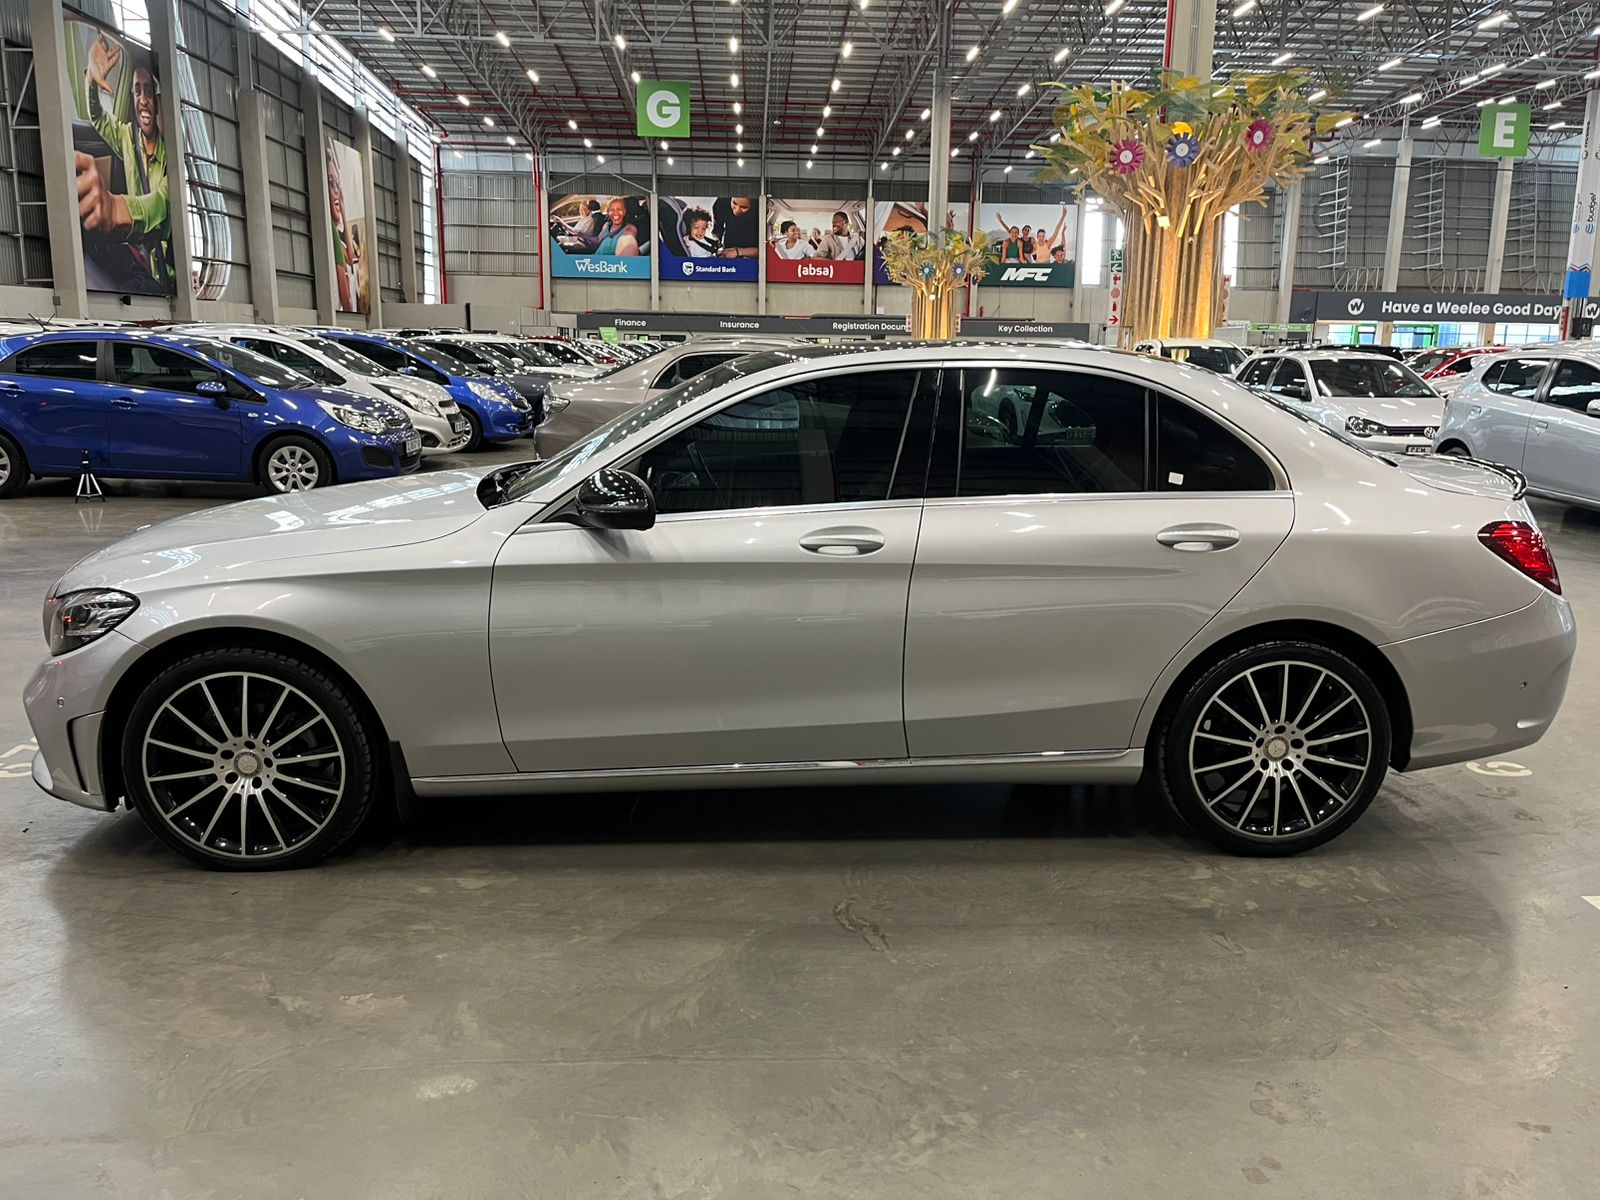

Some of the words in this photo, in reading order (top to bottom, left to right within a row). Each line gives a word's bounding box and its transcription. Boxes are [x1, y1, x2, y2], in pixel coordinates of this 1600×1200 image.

[646, 90, 681, 128] G
[1493, 112, 1517, 148] E
[575, 258, 628, 273] WesBank
[695, 265, 721, 273] Standard
[1000, 267, 1052, 281] MFC
[1381, 301, 1420, 313] Have
[1423, 303, 1433, 314] a
[1436, 301, 1490, 315] Weelee
[1493, 303, 1531, 316] Good
[1533, 303, 1561, 320] Day
[614, 318, 647, 327] Finance
[720, 320, 760, 329] Insurance
[832, 322, 880, 332] Registration
[998, 324, 1013, 334] Key
[1014, 324, 1053, 333] Collection
